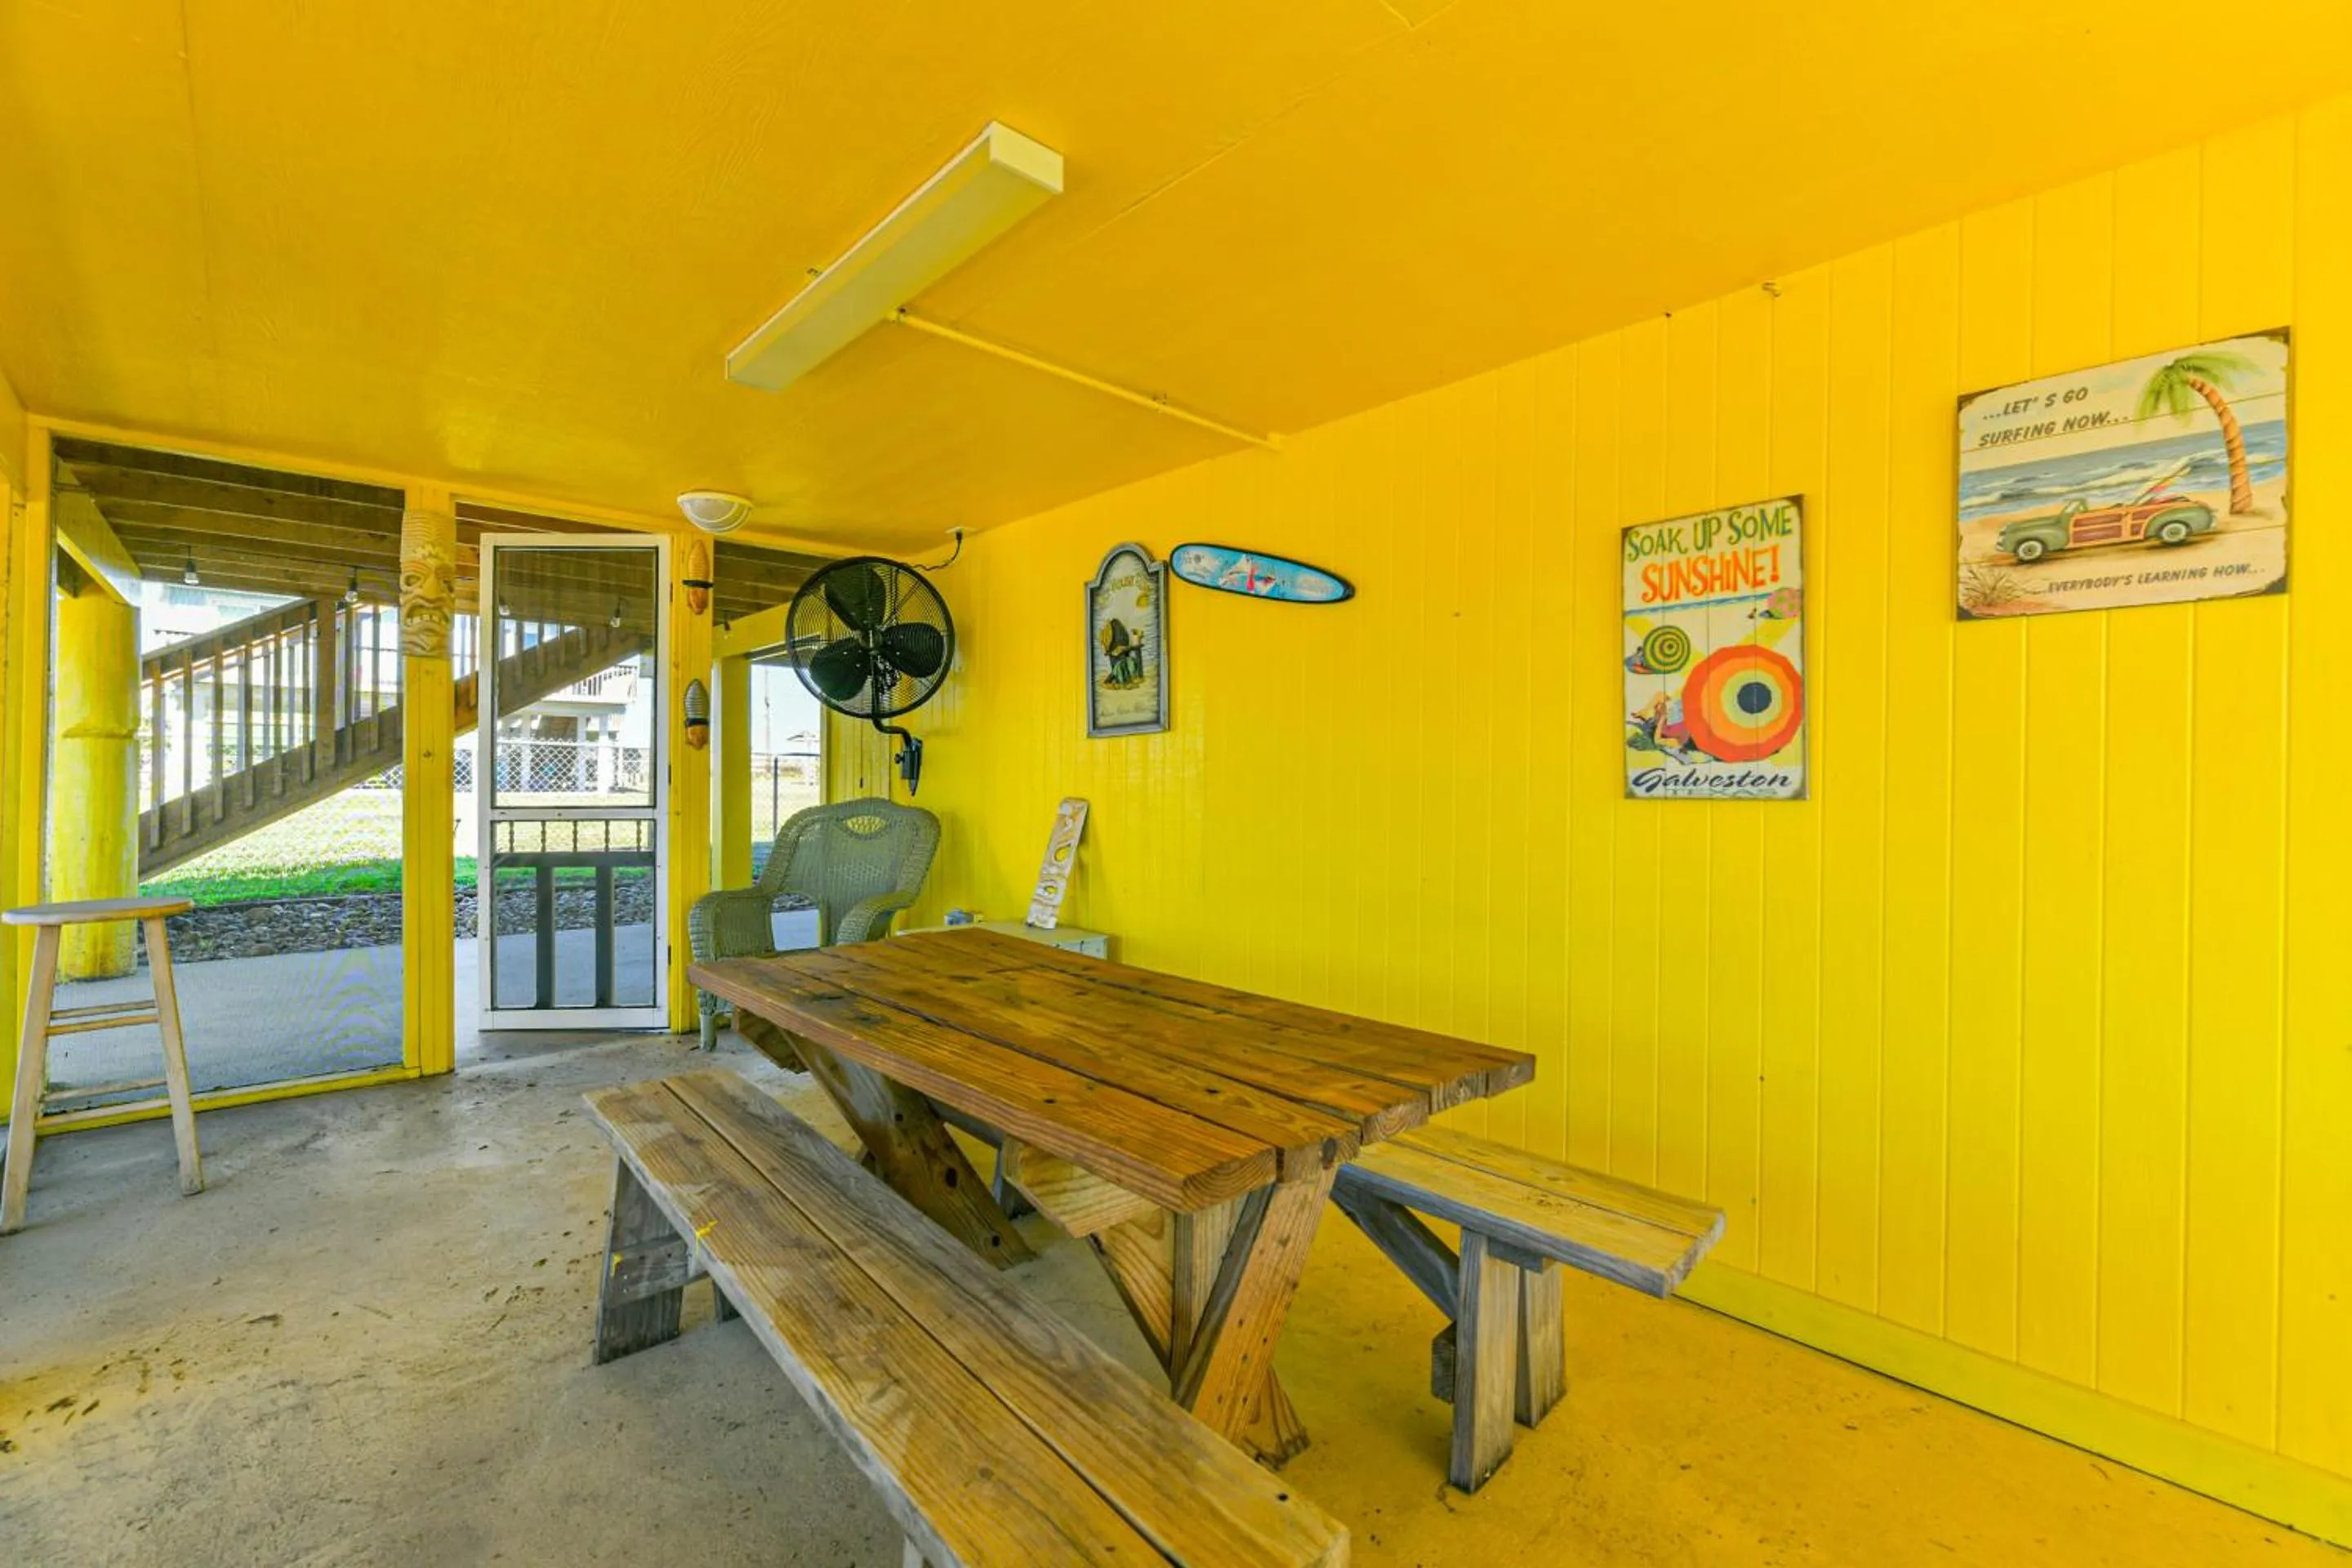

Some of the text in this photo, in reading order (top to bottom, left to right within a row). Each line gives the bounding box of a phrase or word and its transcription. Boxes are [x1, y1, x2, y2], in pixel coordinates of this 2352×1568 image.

[2063, 386, 2088, 404] GO
[1979, 421, 2056, 448] SURFING
[1627, 505, 1793, 561] SOAK UP SOME
[1642, 545, 1780, 603] SUNSHINE!
[2138, 567, 2208, 586] LEARNING
[1633, 768, 1792, 793] Galveston
